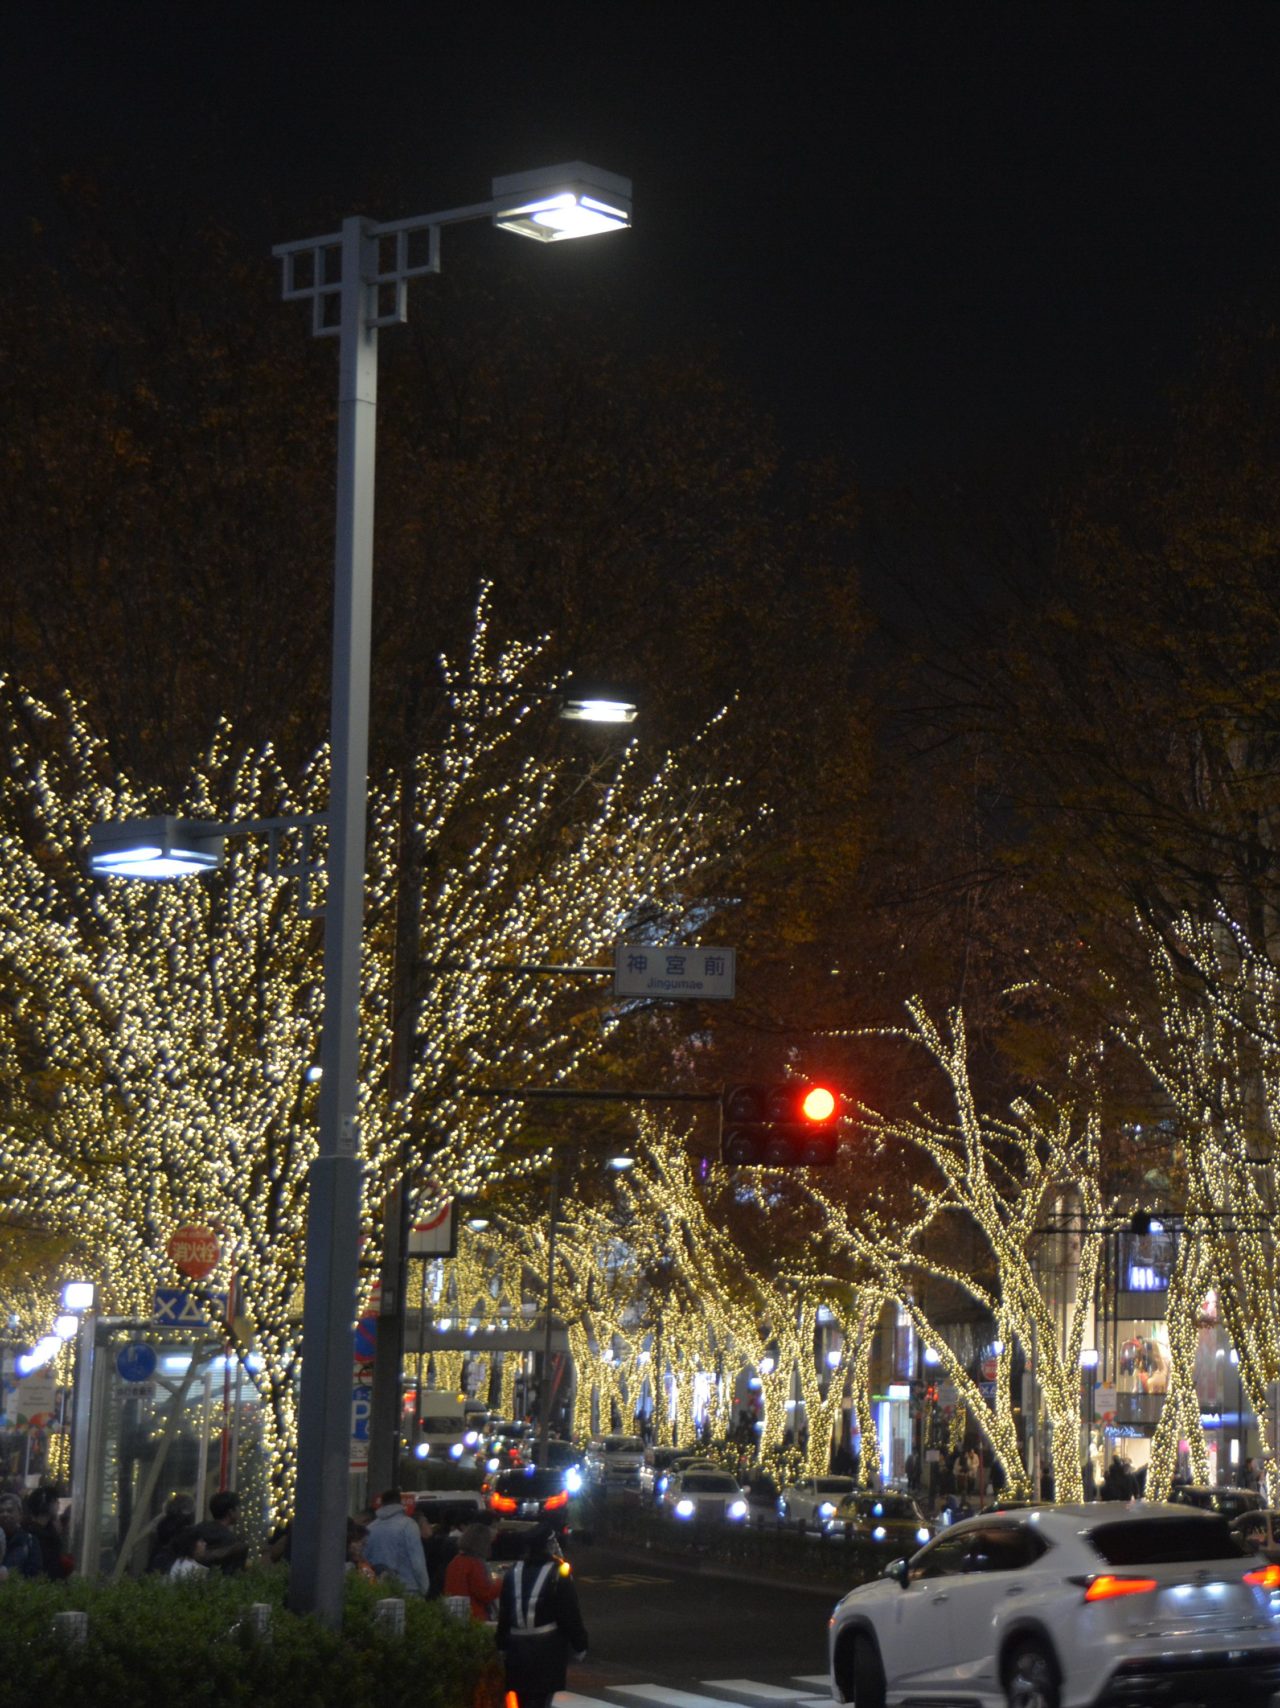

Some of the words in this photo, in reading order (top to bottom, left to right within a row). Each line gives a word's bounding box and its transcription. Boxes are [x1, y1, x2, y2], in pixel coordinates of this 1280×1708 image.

[627, 953, 725, 976] 神宮前
[647, 976, 704, 990] Jingumae
[173, 1240, 217, 1264] 消火栓
[351, 1400, 371, 1436] P
